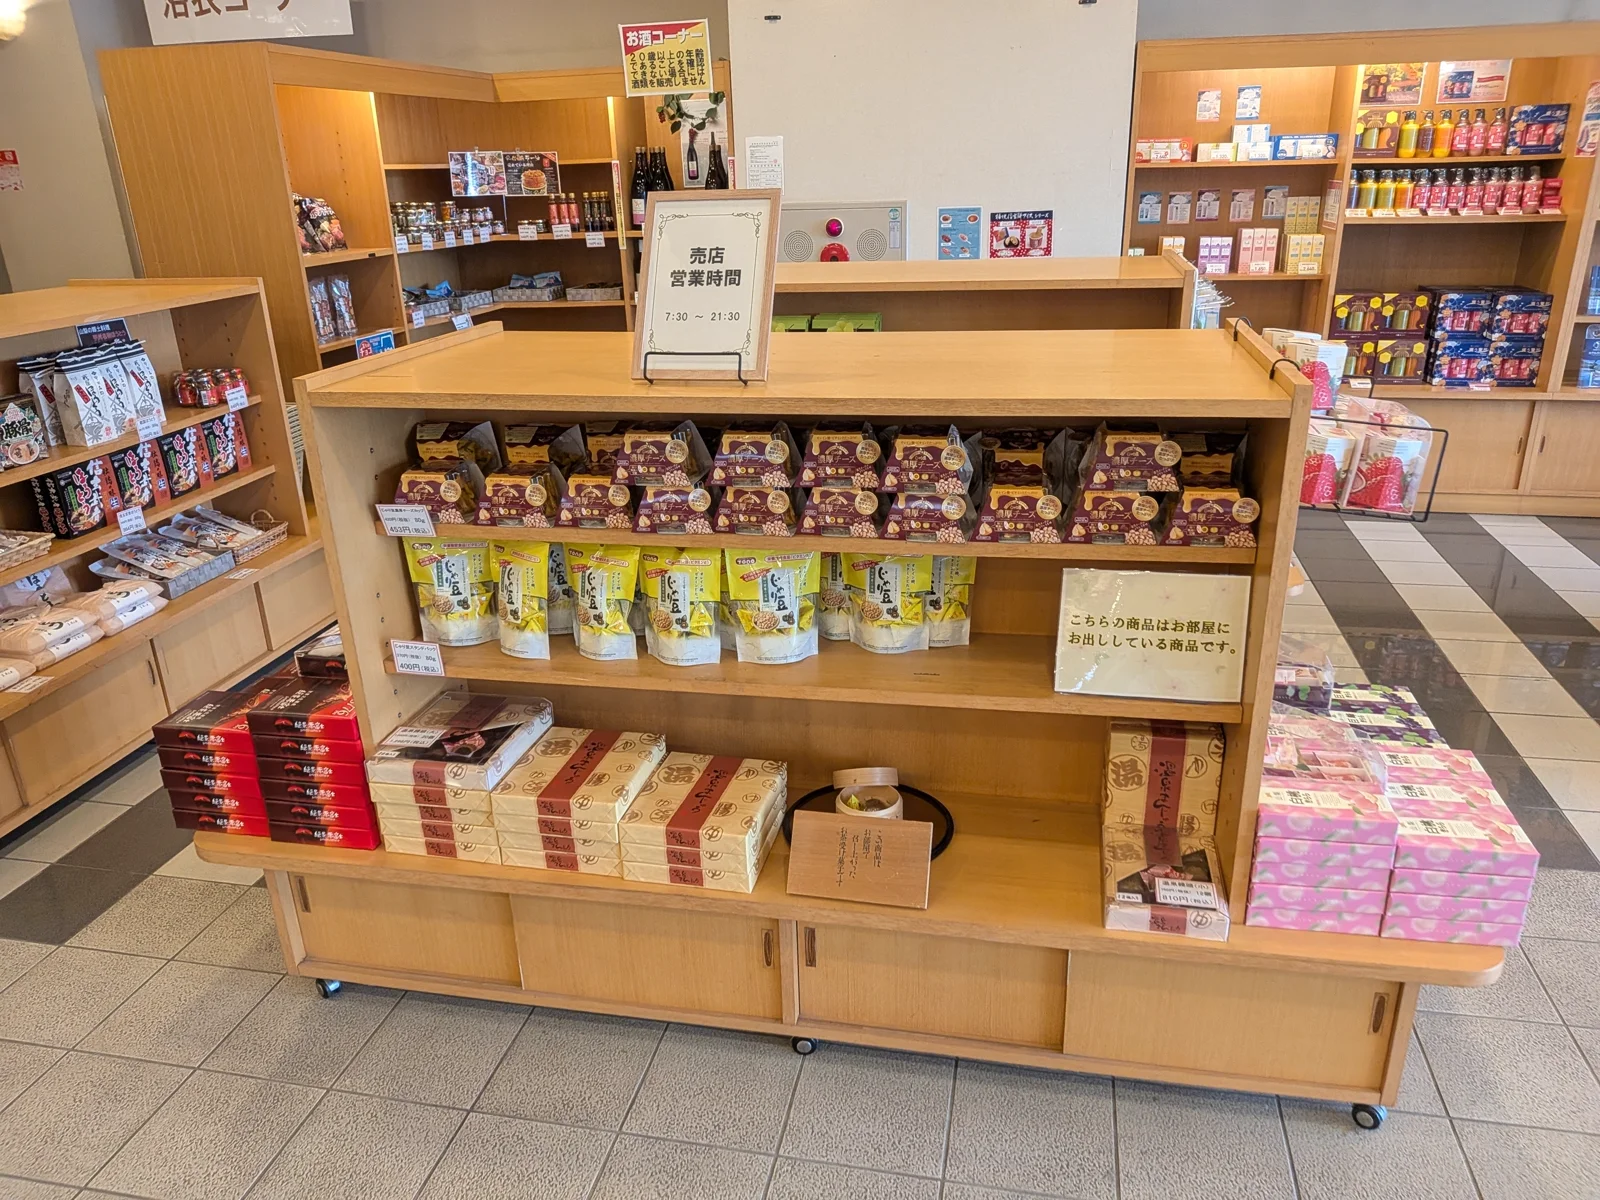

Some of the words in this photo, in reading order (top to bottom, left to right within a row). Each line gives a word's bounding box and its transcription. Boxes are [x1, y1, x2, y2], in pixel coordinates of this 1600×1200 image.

[626, 28, 703, 46] お酒コーナー
[630, 58, 705, 71] であることを確認
[631, 68, 705, 79] できない場合には
[631, 77, 706, 89] 酒類を販売しません
[689, 247, 725, 265] 売店
[670, 269, 742, 288] 営業時間
[665, 312, 688, 321] 7:30
[710, 311, 740, 321] 21:30
[212, 419, 228, 462] ほうとう
[172, 434, 189, 479] ほうとう
[630, 453, 666, 463] 濃厚チーズ
[728, 455, 766, 463] 濃厚チーズ
[818, 454, 856, 464] 濃厚チーズ
[1111, 456, 1154, 466] 濃厚チーズ
[901, 459, 941, 469] 濃厚チーズ
[125, 450, 143, 496] ほうとう
[72, 467, 92, 516] ほうとう
[406, 492, 441, 502] 濃厚チーズ
[109, 497, 120, 509] 生
[491, 495, 527, 505] 濃厚チーズ
[574, 495, 610, 506] 濃厚チーズ
[652, 503, 689, 511] 濃厚チーズ
[732, 503, 767, 512] 濃厚チーズ
[818, 503, 856, 512] 濃厚チーズ
[902, 508, 942, 518] 濃厚チーズ
[995, 509, 1036, 520] 濃厚チーズ
[1089, 510, 1132, 520] 濃厚チーズ
[1188, 511, 1232, 523] 濃厚チーズ
[876, 566, 894, 604] じゃり豆
[667, 575, 682, 614] じゃり豆
[771, 573, 789, 614] じゃり豆
[1069, 614, 1231, 635] こちらの商品はお部屋に
[1068, 632, 1237, 655] お出ししている商品です。
[399, 663, 440, 673] 400円(税込)
[862, 828, 872, 860] お部屋で
[1162, 894, 1213, 905] 810円(税込)
